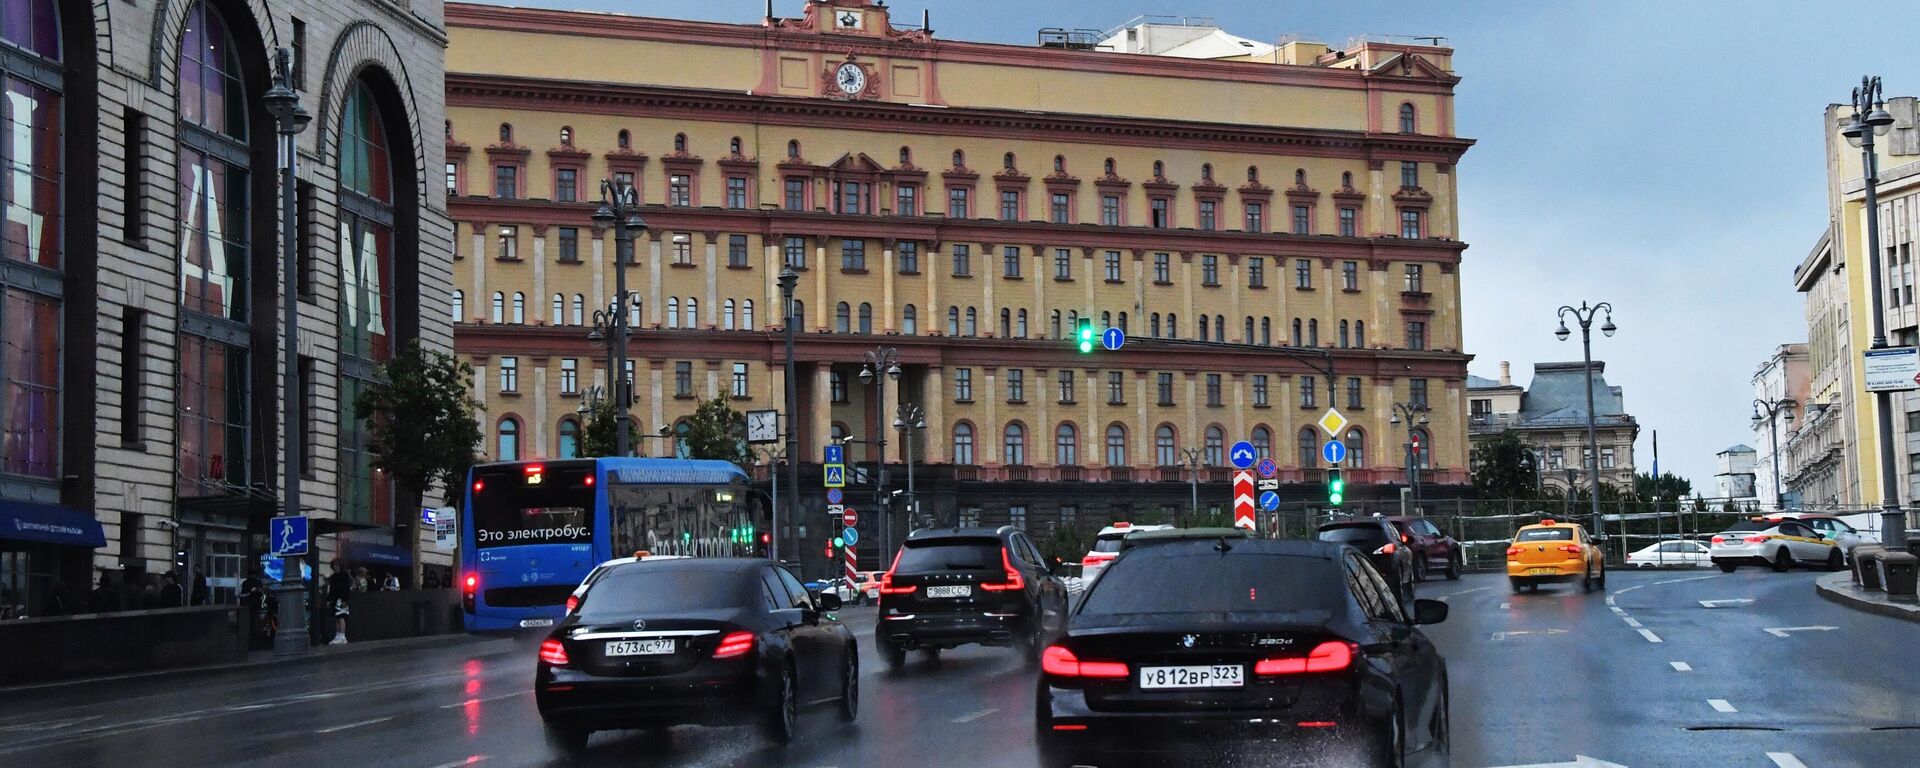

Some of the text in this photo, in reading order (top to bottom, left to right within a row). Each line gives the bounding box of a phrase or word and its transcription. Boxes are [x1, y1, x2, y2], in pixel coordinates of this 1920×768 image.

[478, 524, 591, 541] Это электробус.
[1213, 666, 1239, 680] 323
